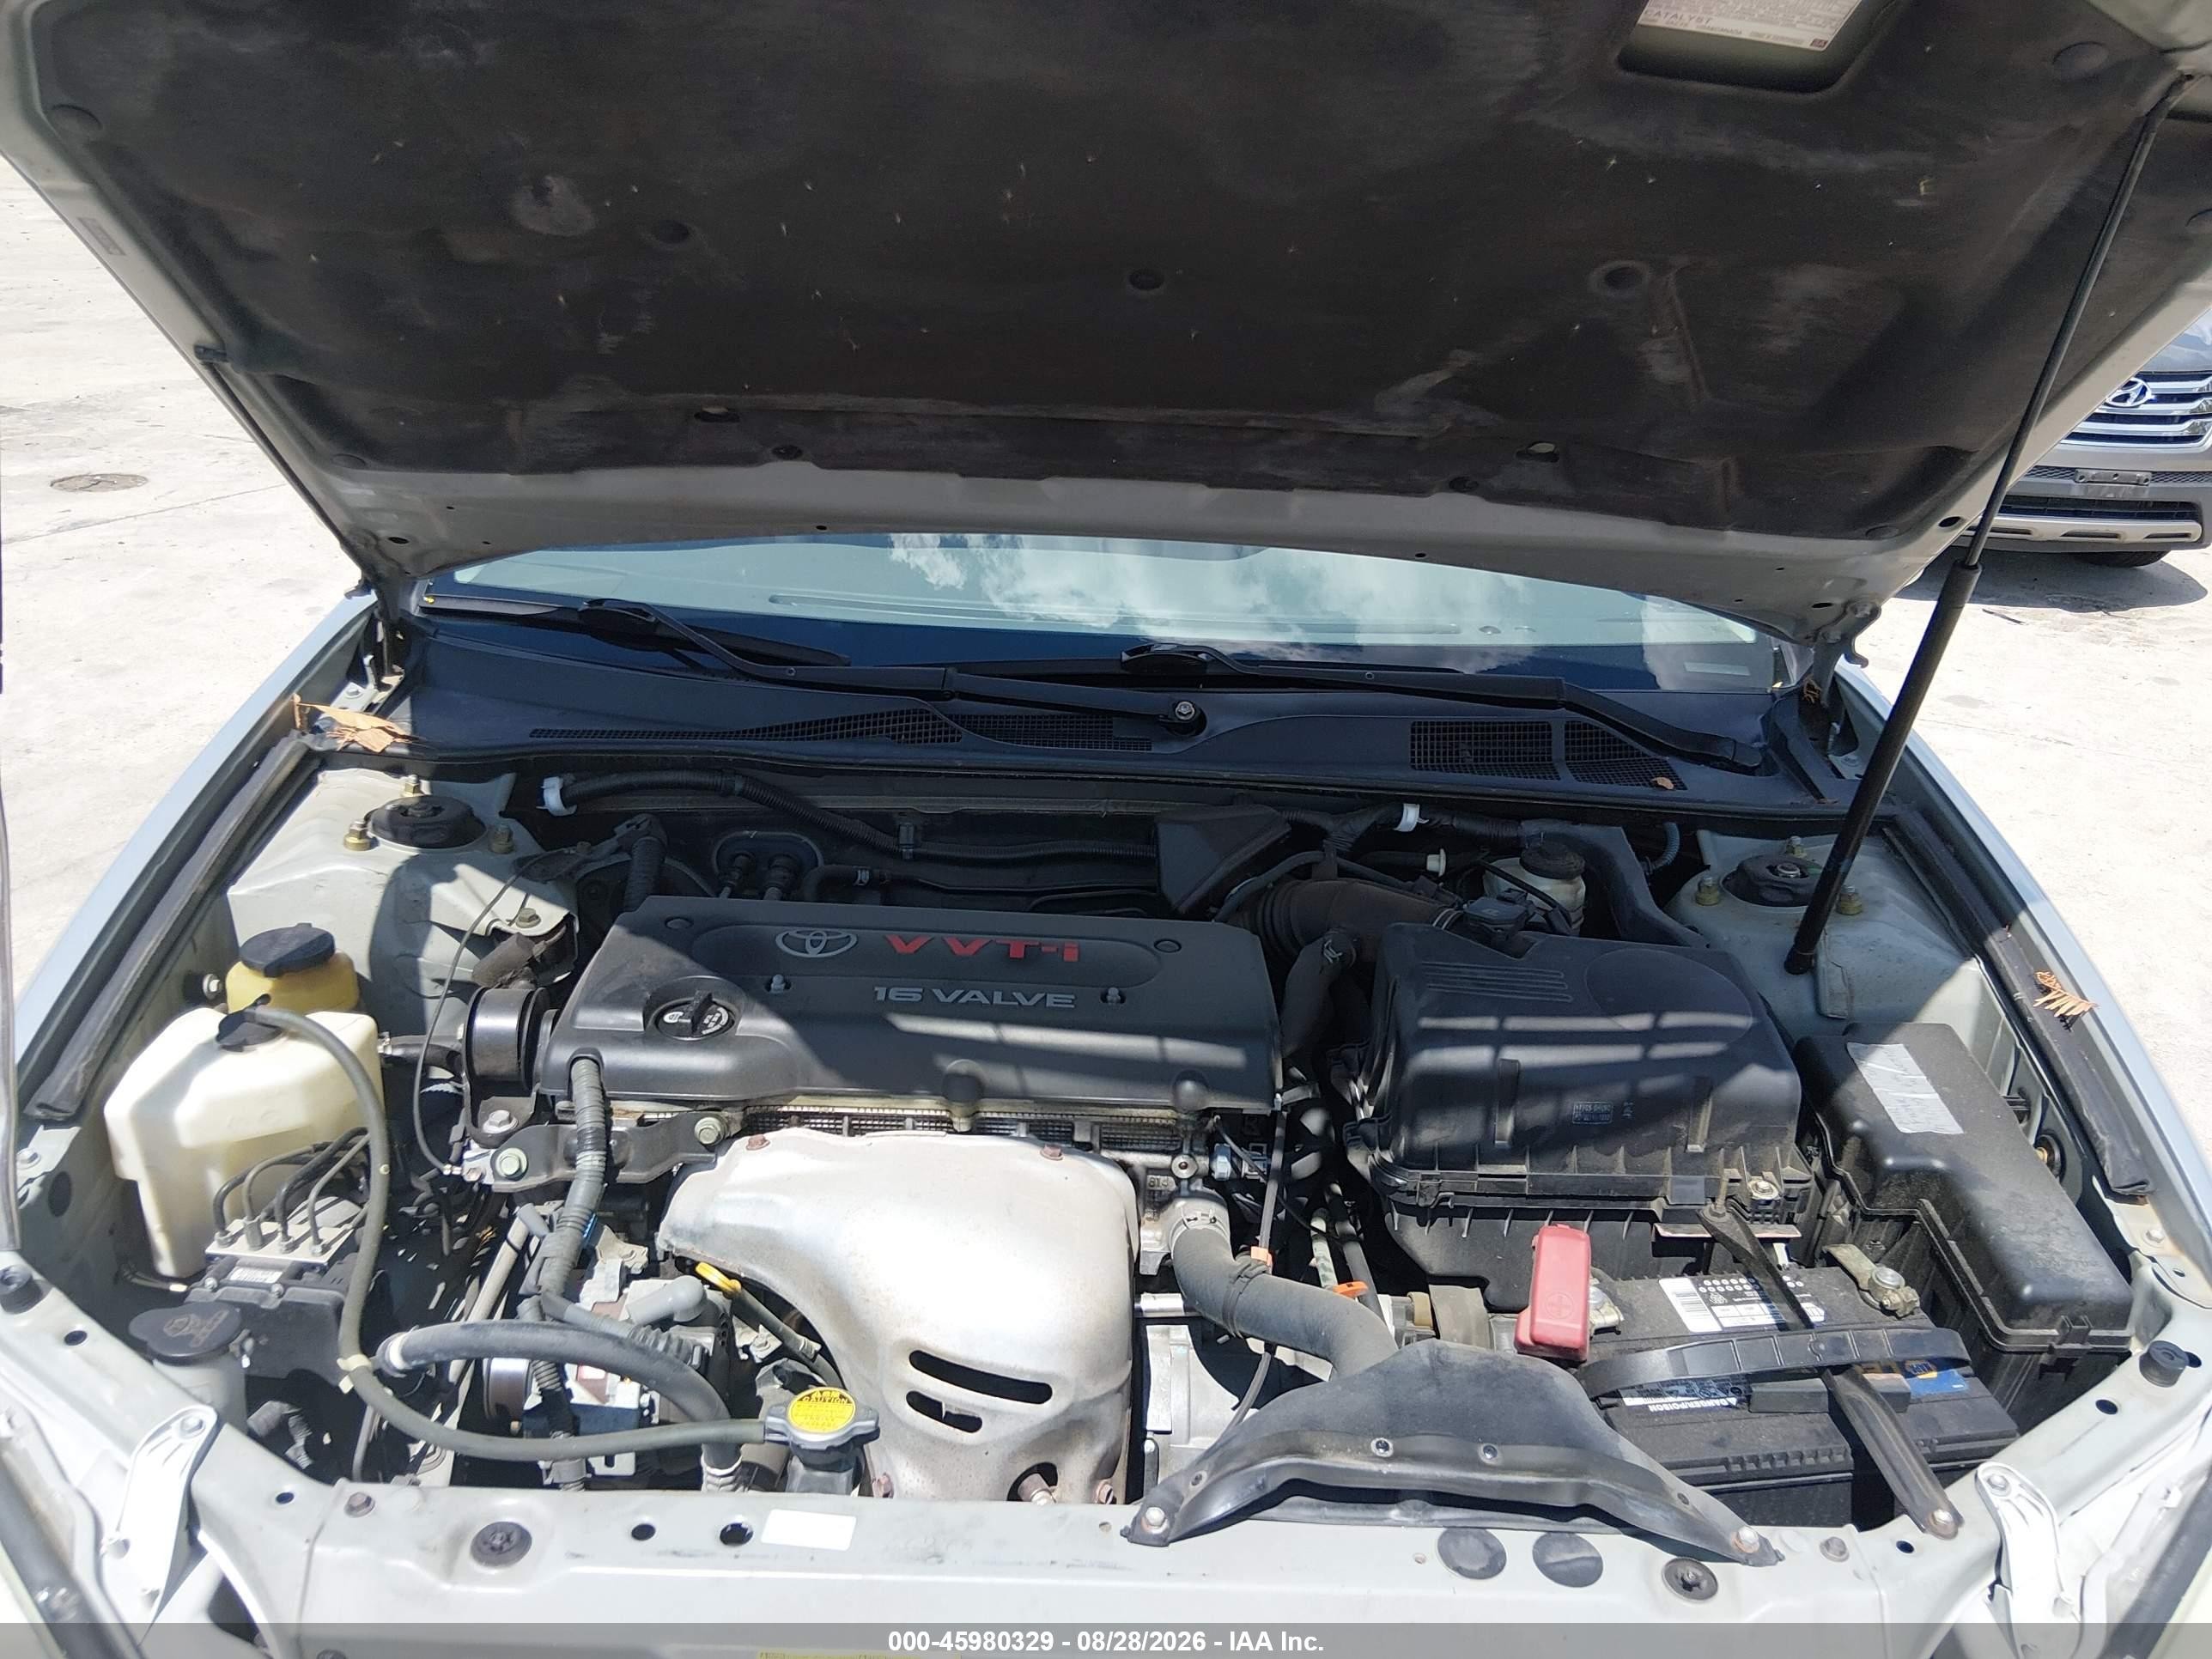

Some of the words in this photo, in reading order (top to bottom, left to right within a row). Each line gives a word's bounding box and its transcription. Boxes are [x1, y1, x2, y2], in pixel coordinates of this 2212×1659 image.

[1644, 9, 1712, 24] CATALYST
[873, 986, 924, 1003] 16
[931, 988, 1077, 1009] VALVE
[1648, 1397, 1729, 1413] DANGER/POISON
